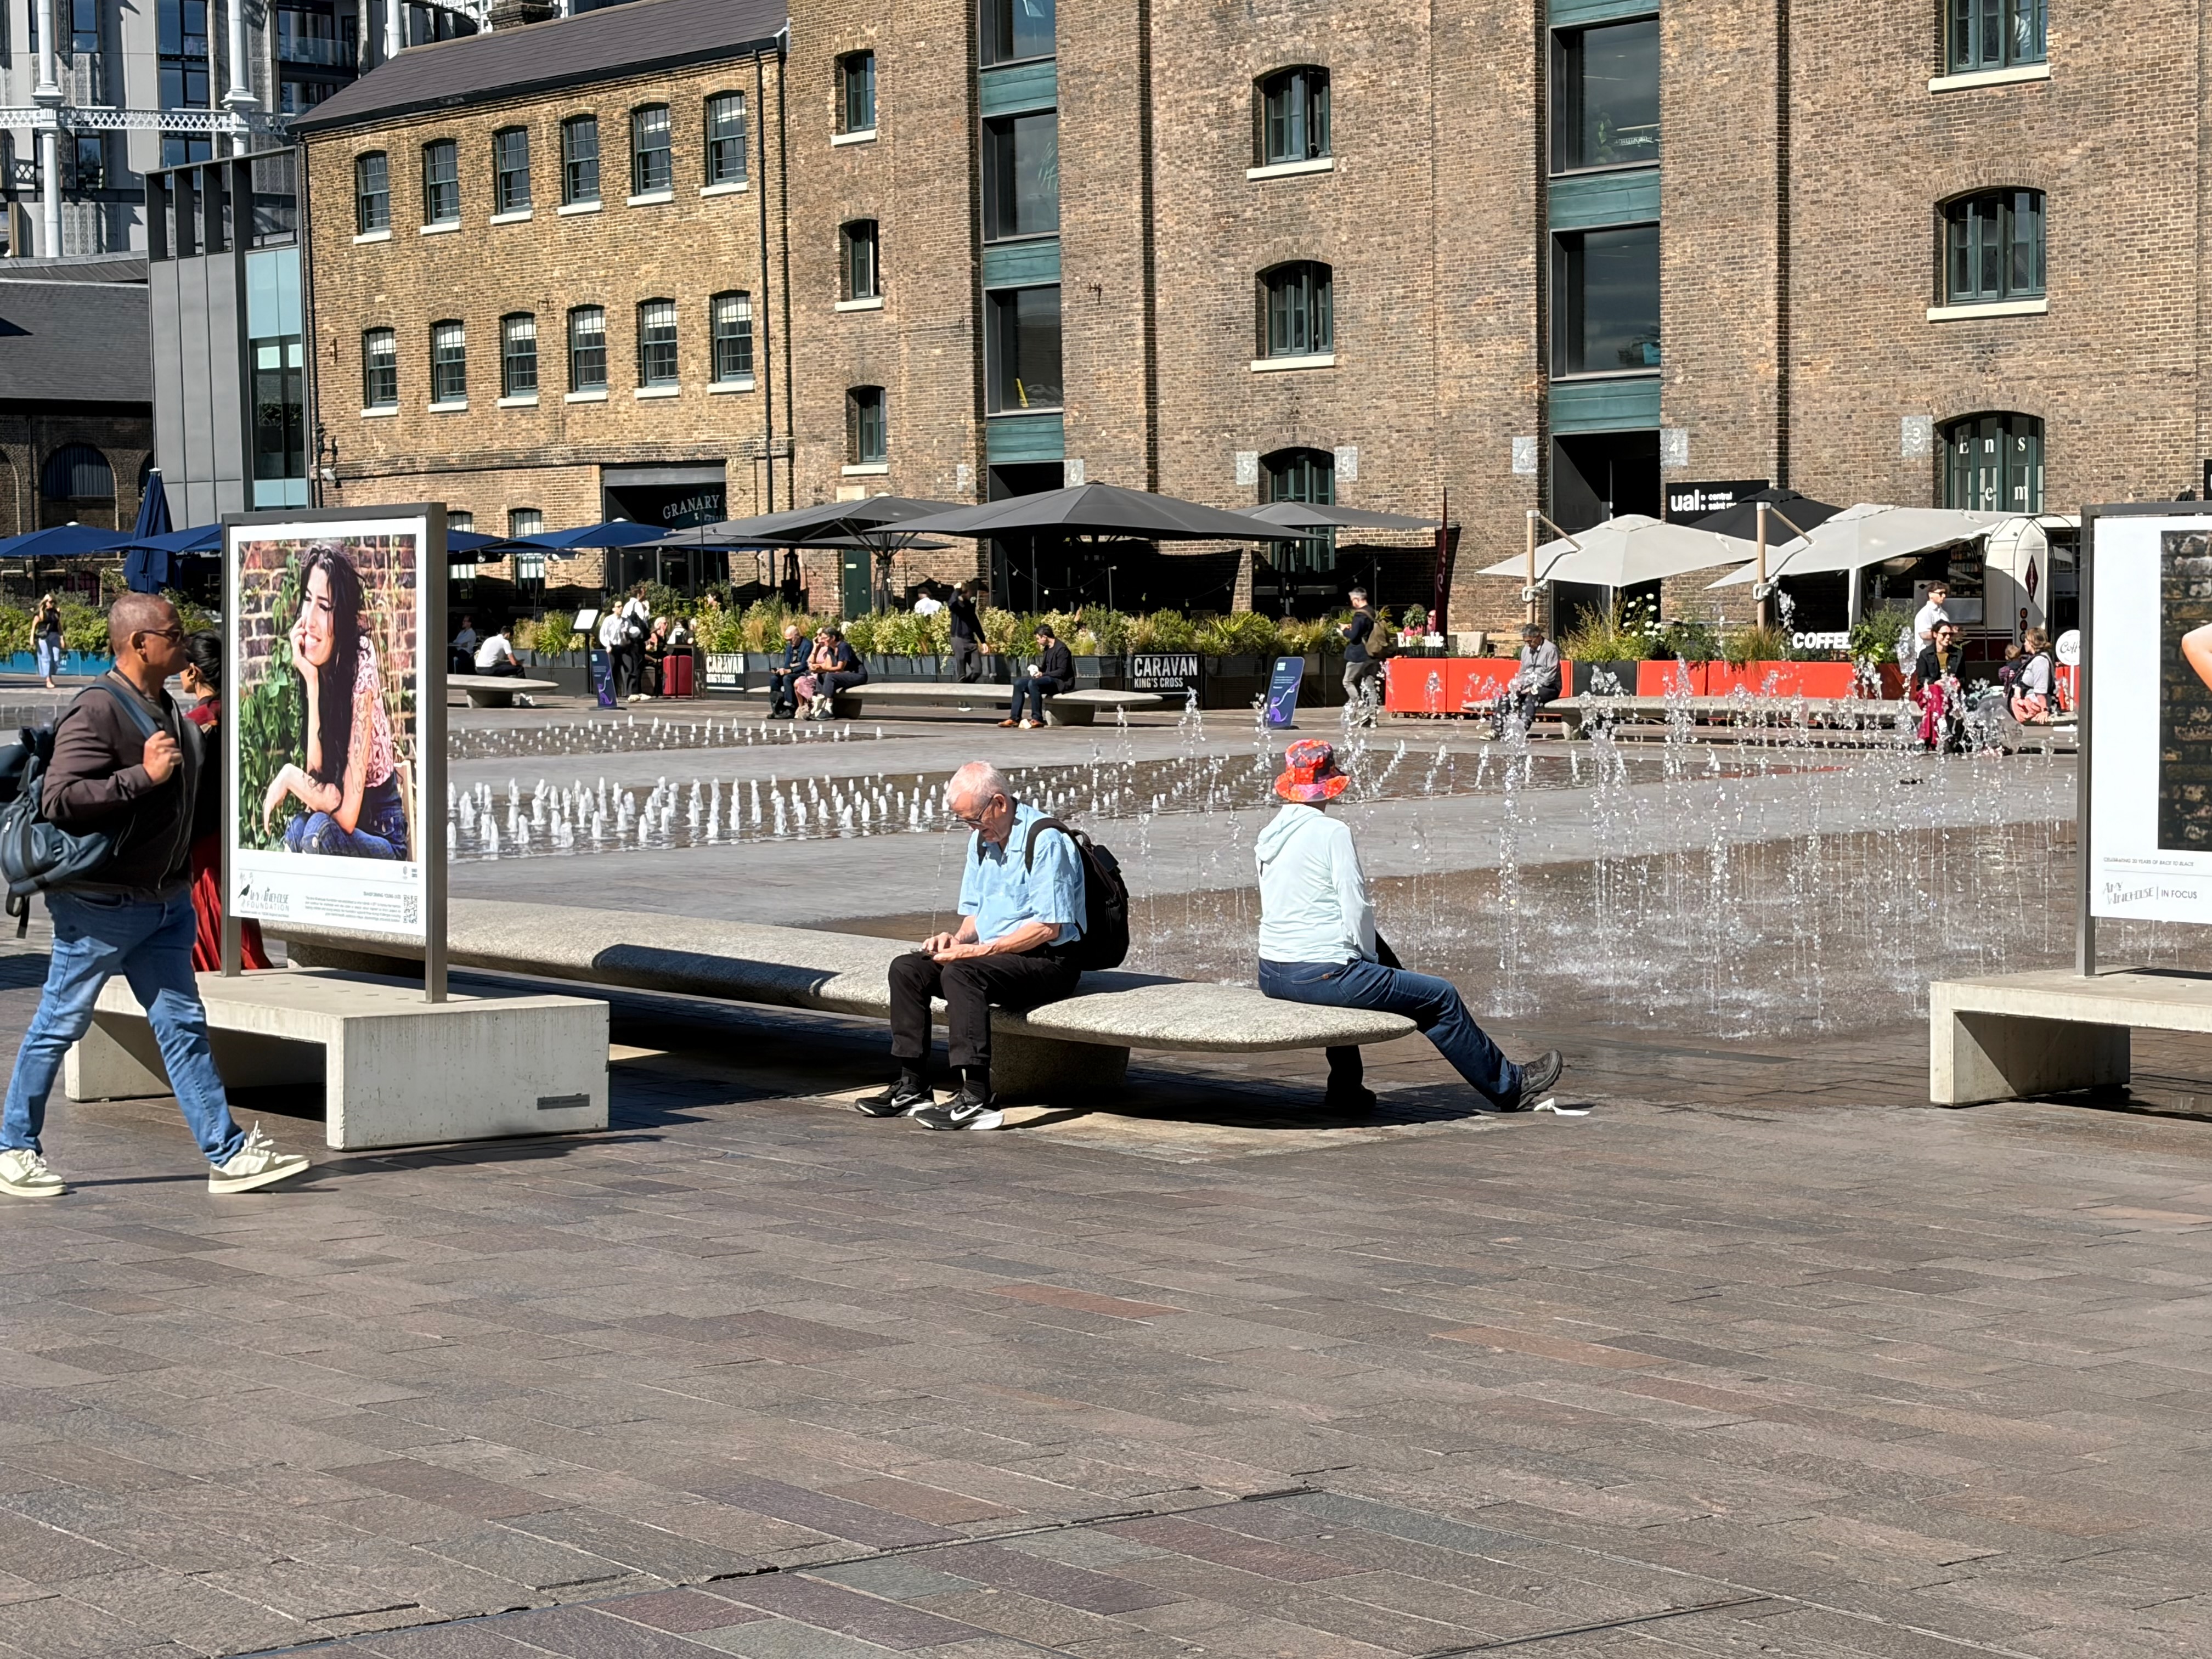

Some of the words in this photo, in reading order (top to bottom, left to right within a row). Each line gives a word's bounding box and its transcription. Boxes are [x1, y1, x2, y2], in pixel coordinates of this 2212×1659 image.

[1243, 460, 1250, 475] 5
[1708, 492, 1733, 500] central
[663, 494, 720, 520] GRANARY
[1708, 501, 1725, 510] saint
[1792, 632, 1852, 649] COFFEE
[706, 656, 744, 674] CARAVAN
[1134, 657, 1198, 676] CARAVAN
[1134, 678, 1158, 689] KING'S
[1160, 677, 1183, 688] CROSS
[2161, 889, 2169, 898] IN
[2171, 889, 2197, 899] FOCUS
[247, 900, 290, 912] FOUNDATION
